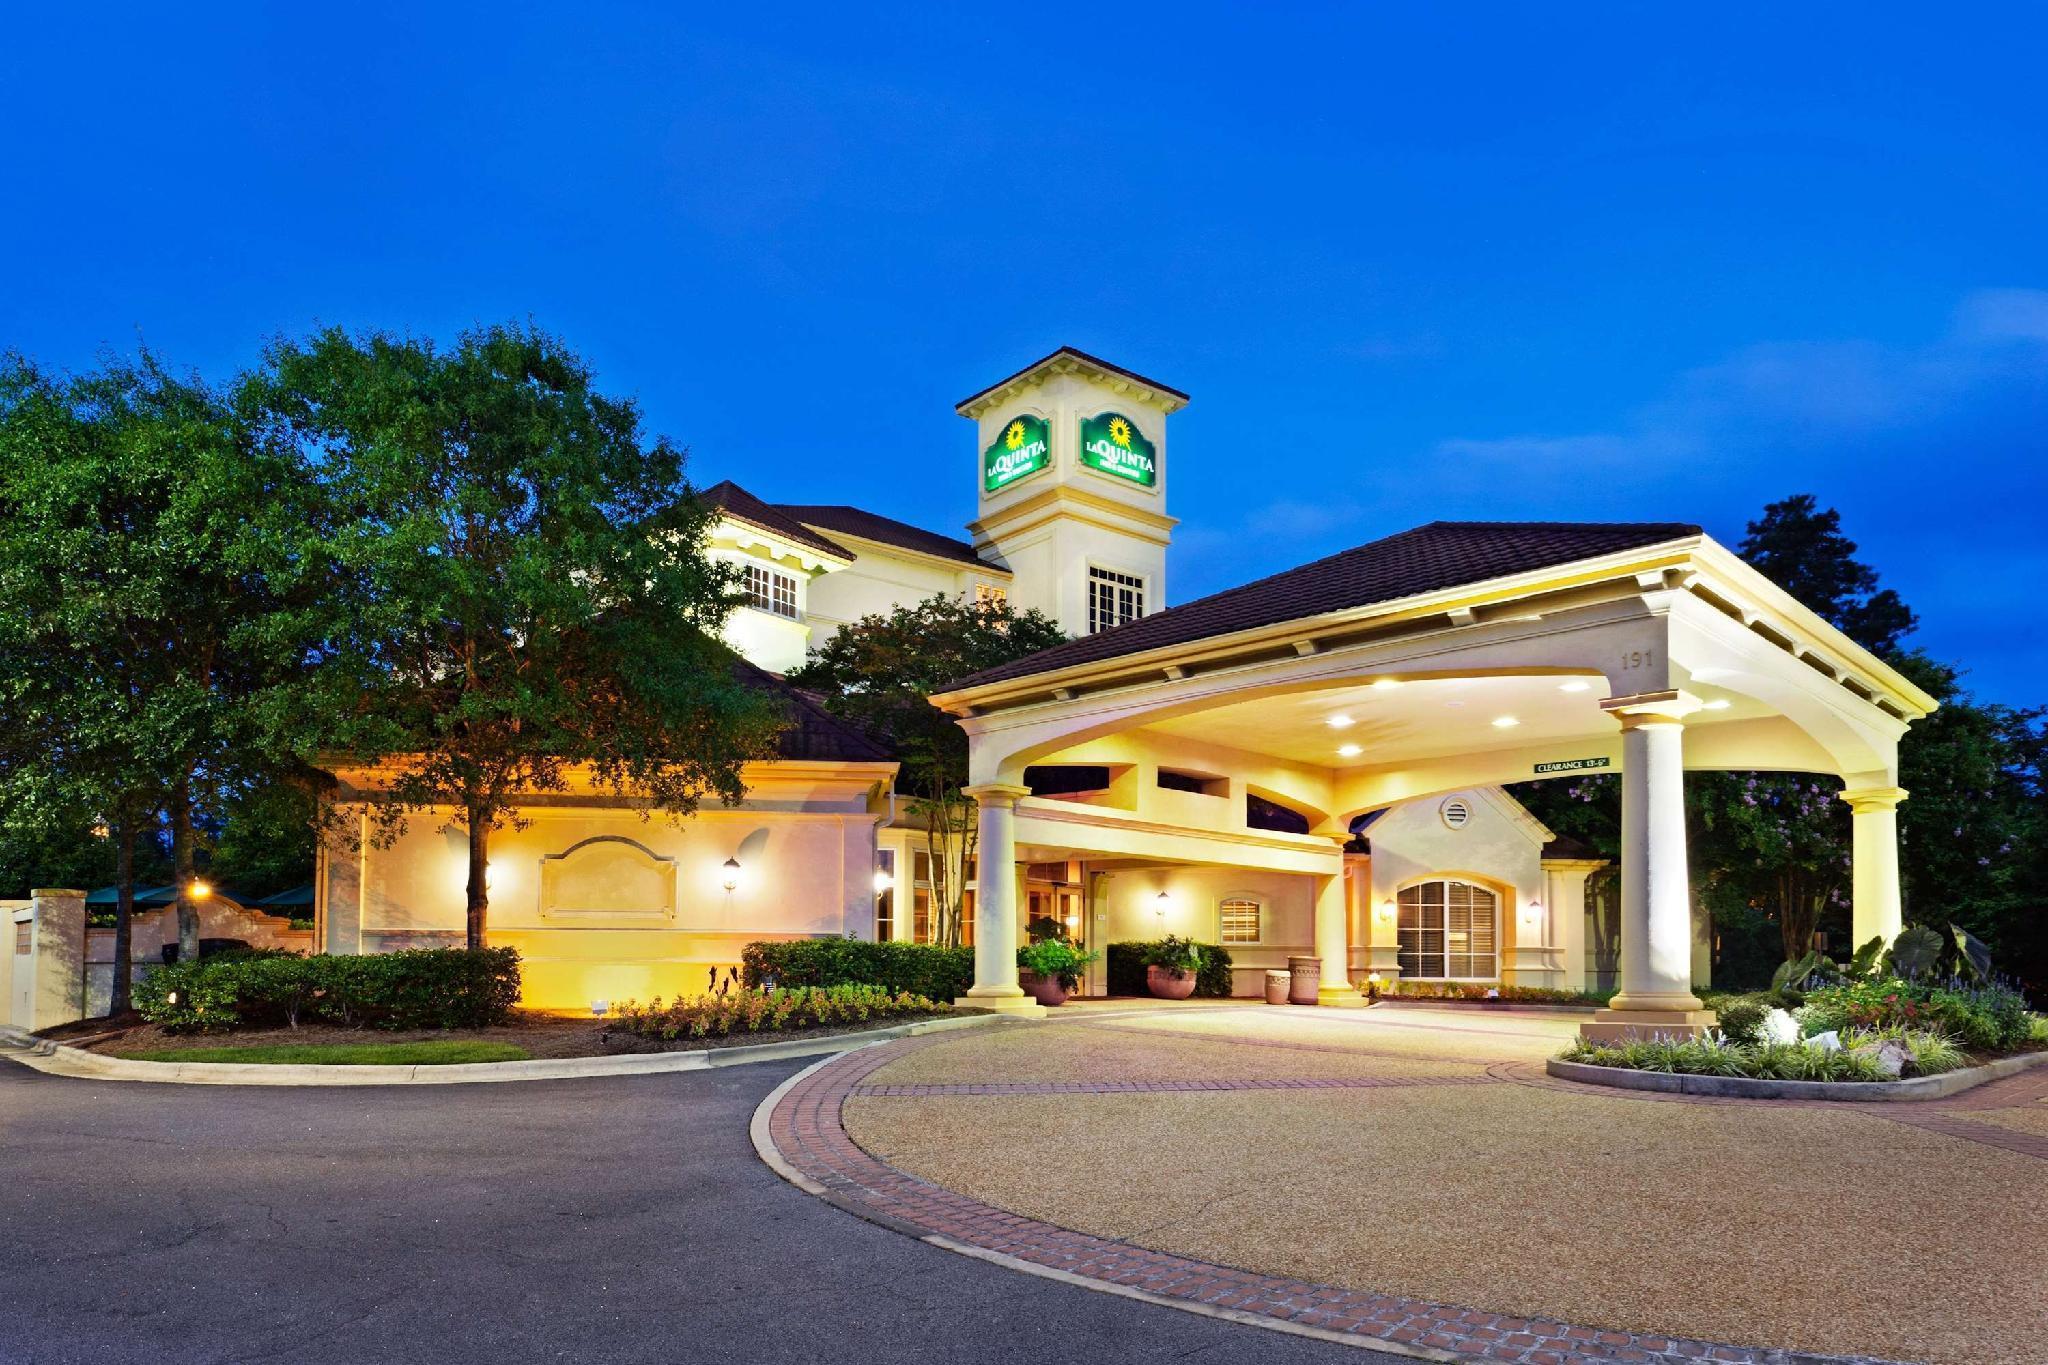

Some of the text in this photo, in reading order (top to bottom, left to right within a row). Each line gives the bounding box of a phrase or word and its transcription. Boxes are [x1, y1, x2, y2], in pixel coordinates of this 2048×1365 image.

[988, 465, 998, 477] LA
[995, 439, 1047, 473] QUINTA
[1086, 441, 1097, 453] LA
[1096, 439, 1155, 473] QUINTA
[1621, 648, 1653, 670] 191
[1537, 761, 1583, 773] CLEARANCE
